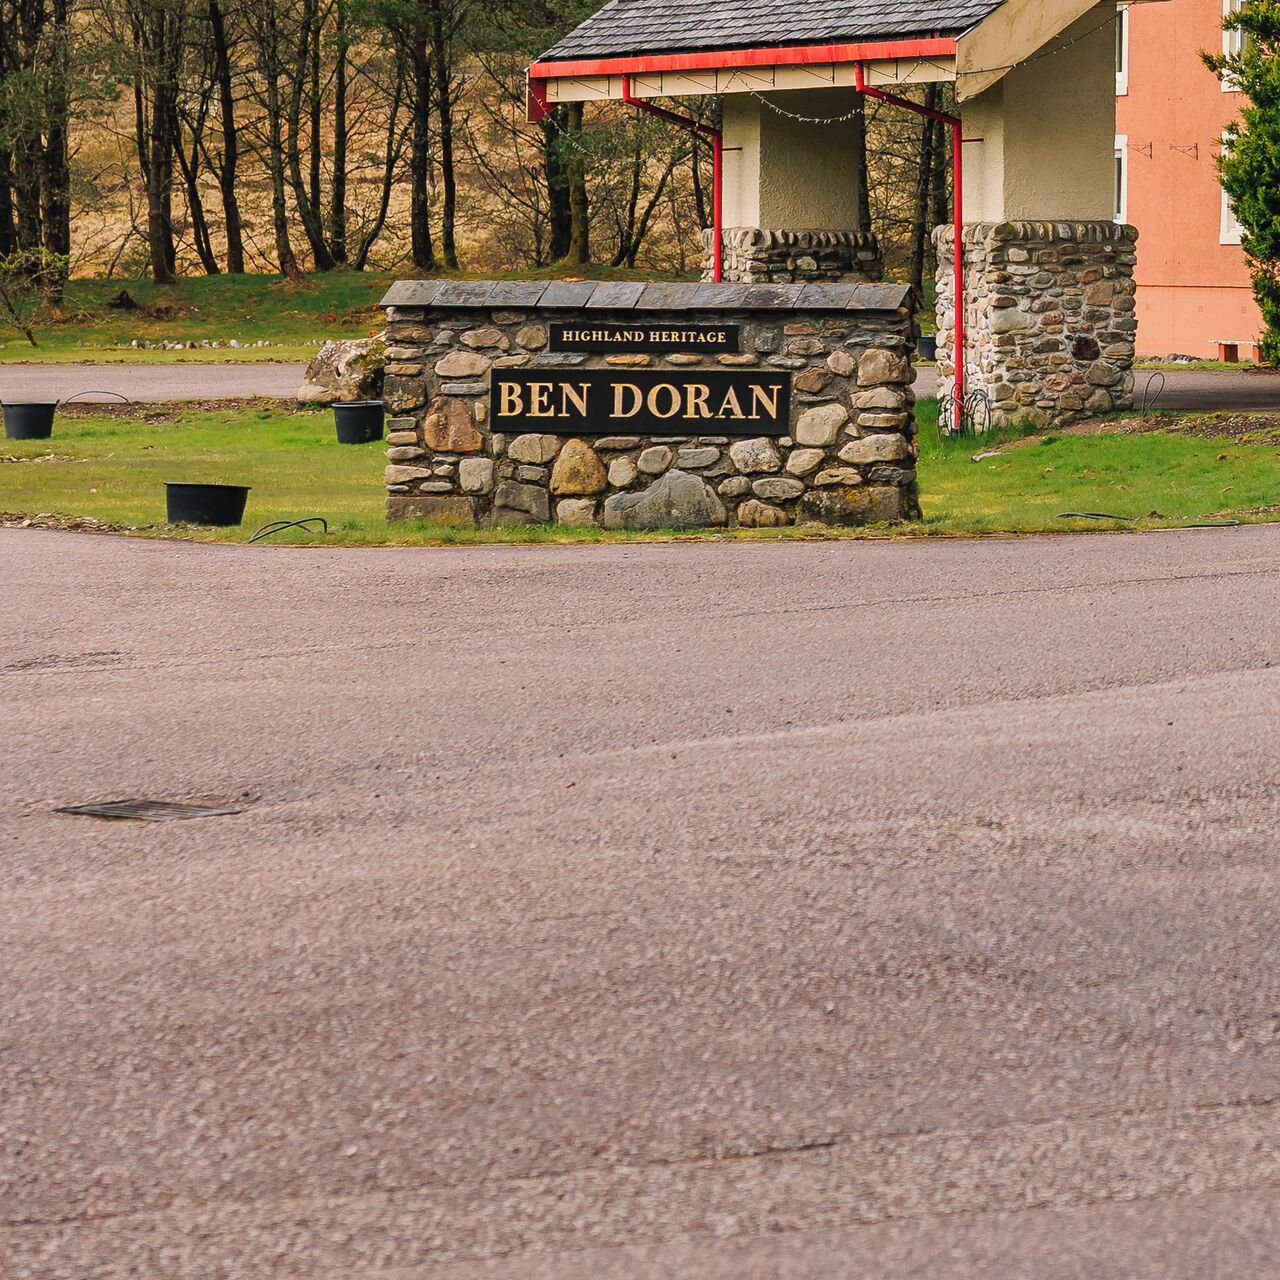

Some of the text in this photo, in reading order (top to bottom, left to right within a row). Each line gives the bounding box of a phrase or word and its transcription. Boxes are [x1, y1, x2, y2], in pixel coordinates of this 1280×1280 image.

[562, 330, 726, 343] HIGHLAND HERITAGE
[497, 382, 783, 420] BEN DORAN
